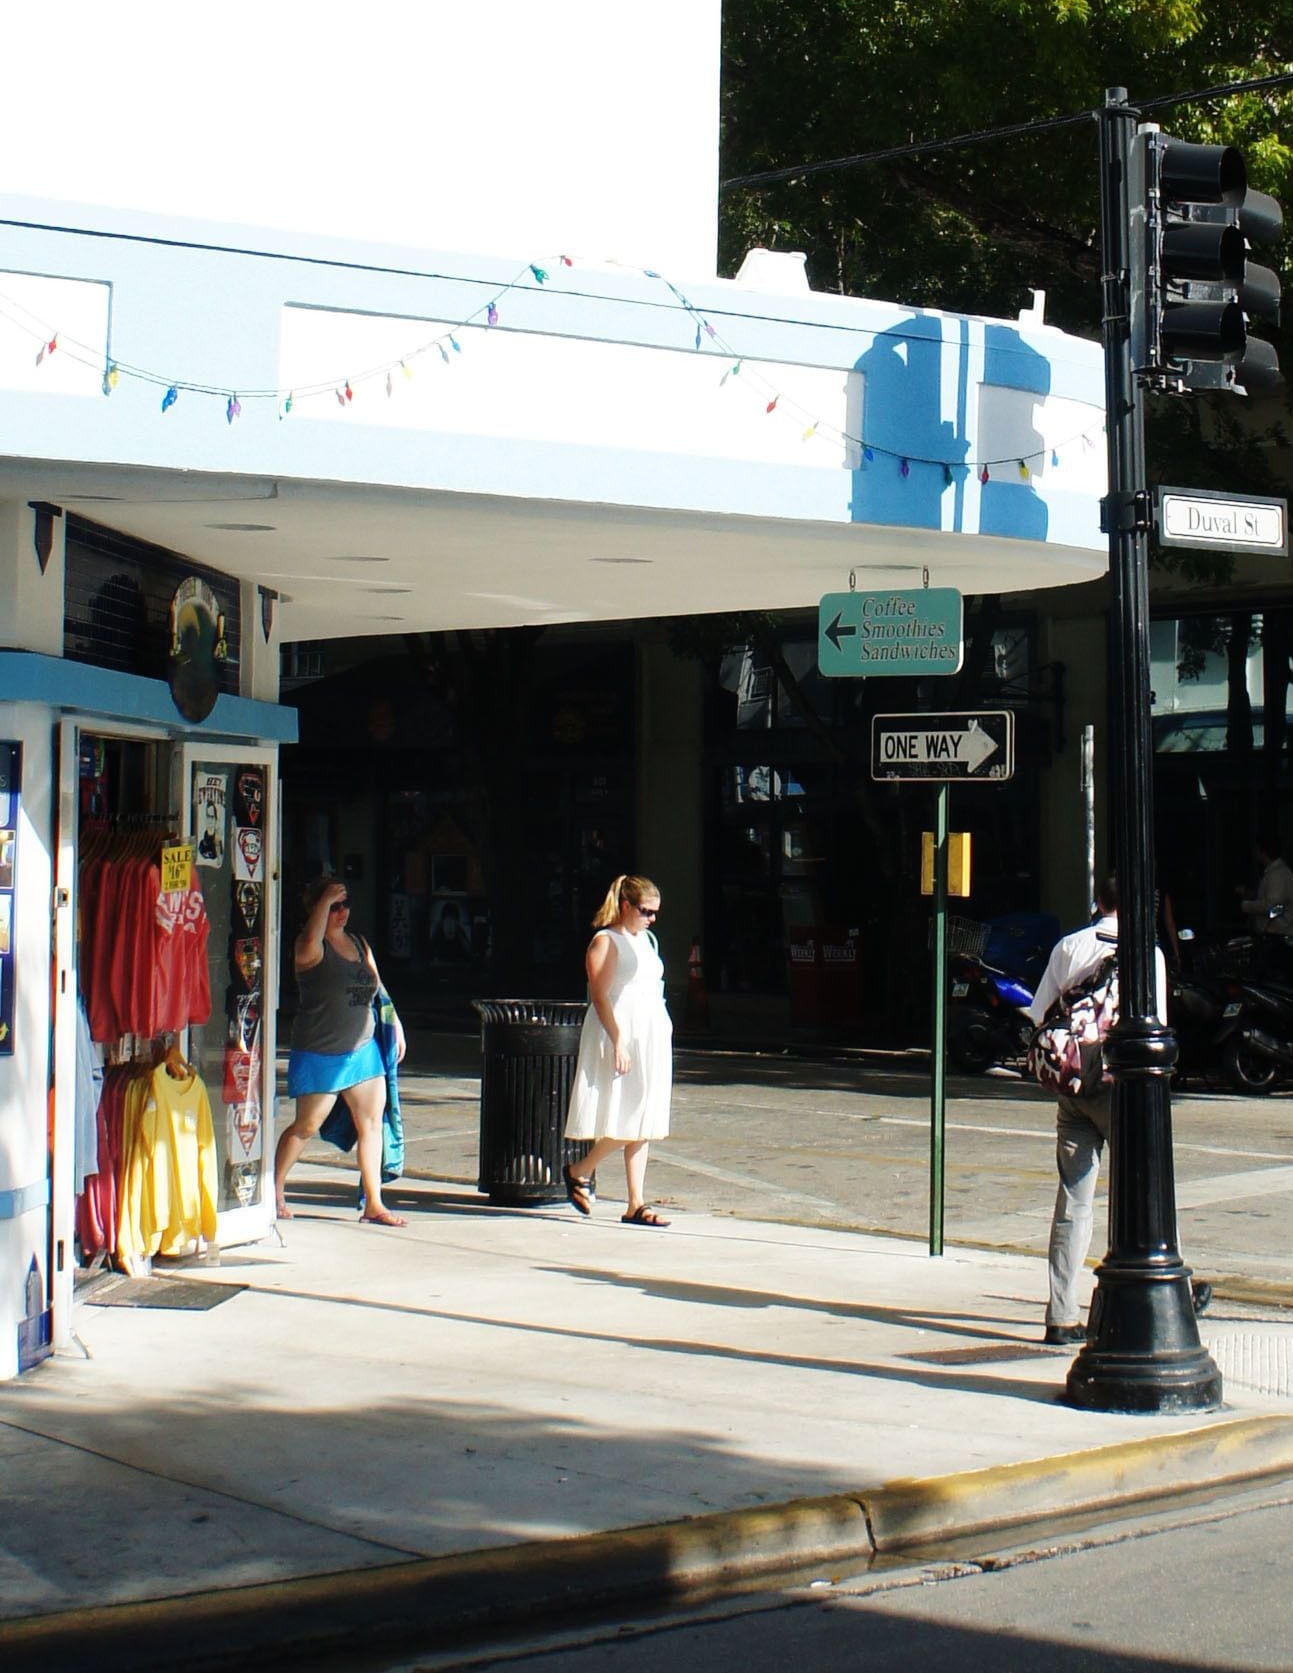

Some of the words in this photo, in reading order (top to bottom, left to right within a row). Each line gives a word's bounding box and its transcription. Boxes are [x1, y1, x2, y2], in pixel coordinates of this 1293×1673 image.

[1187, 506, 1238, 535] Duval
[1243, 512, 1260, 537] St
[862, 596, 917, 617] Coffee
[861, 618, 946, 640] Smoothies
[860, 640, 957, 662] Sandwiches
[884, 734, 919, 760] ONE
[925, 734, 963, 759] WAY
[163, 849, 192, 865] SALE
